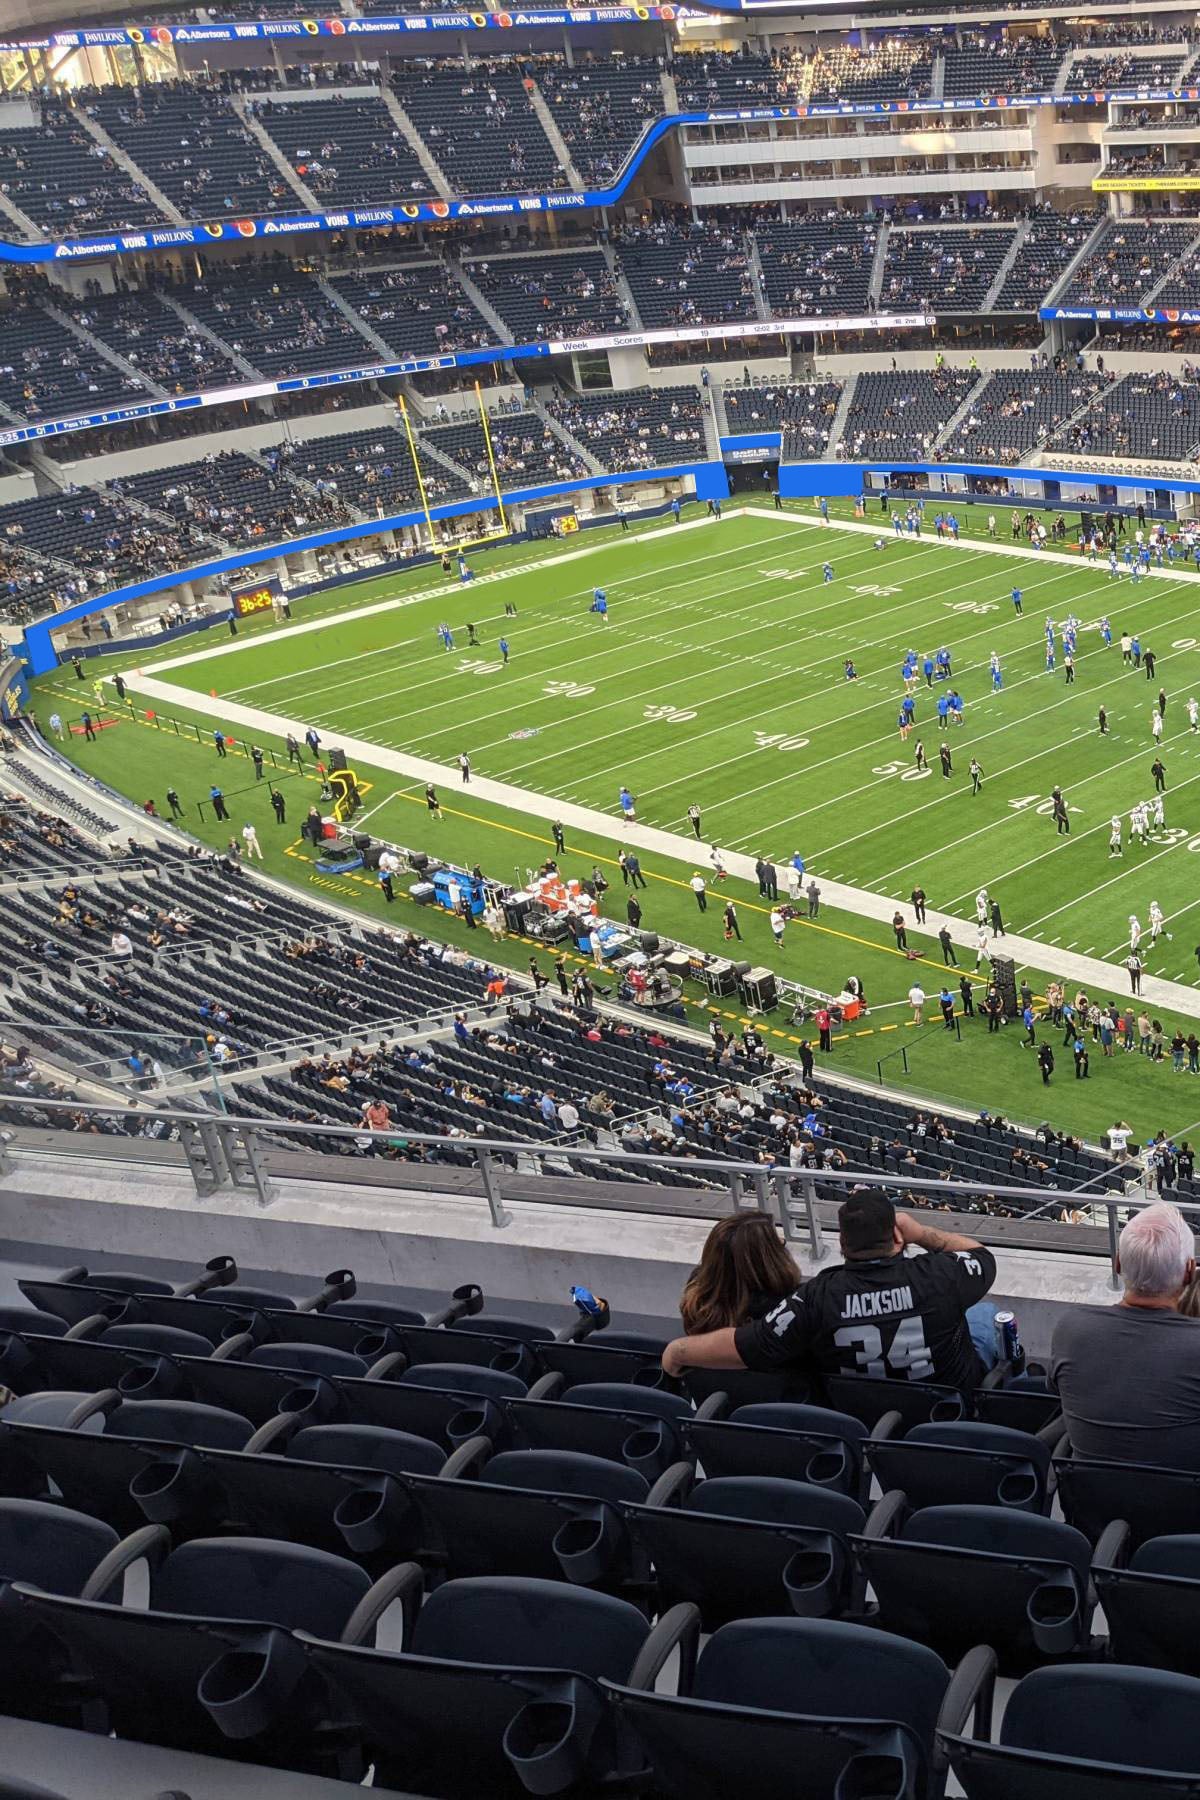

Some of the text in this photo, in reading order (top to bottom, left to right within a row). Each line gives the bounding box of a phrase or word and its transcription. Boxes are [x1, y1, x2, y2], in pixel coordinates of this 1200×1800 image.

[474, 195, 585, 214] Albertsons VONS PAVILIONS
[279, 211, 394, 232] Albertsons VONS PAVILIONS
[72, 231, 194, 255] Albertsons VONS PAVILIONS
[562, 341, 589, 351] Week
[613, 336, 643, 345] Scores
[240, 591, 272, 614] 36:25
[871, 760, 933, 781] 50
[840, 1286, 914, 1319] JACKSON
[765, 1299, 796, 1337] 34
[834, 1316, 935, 1381] 34
